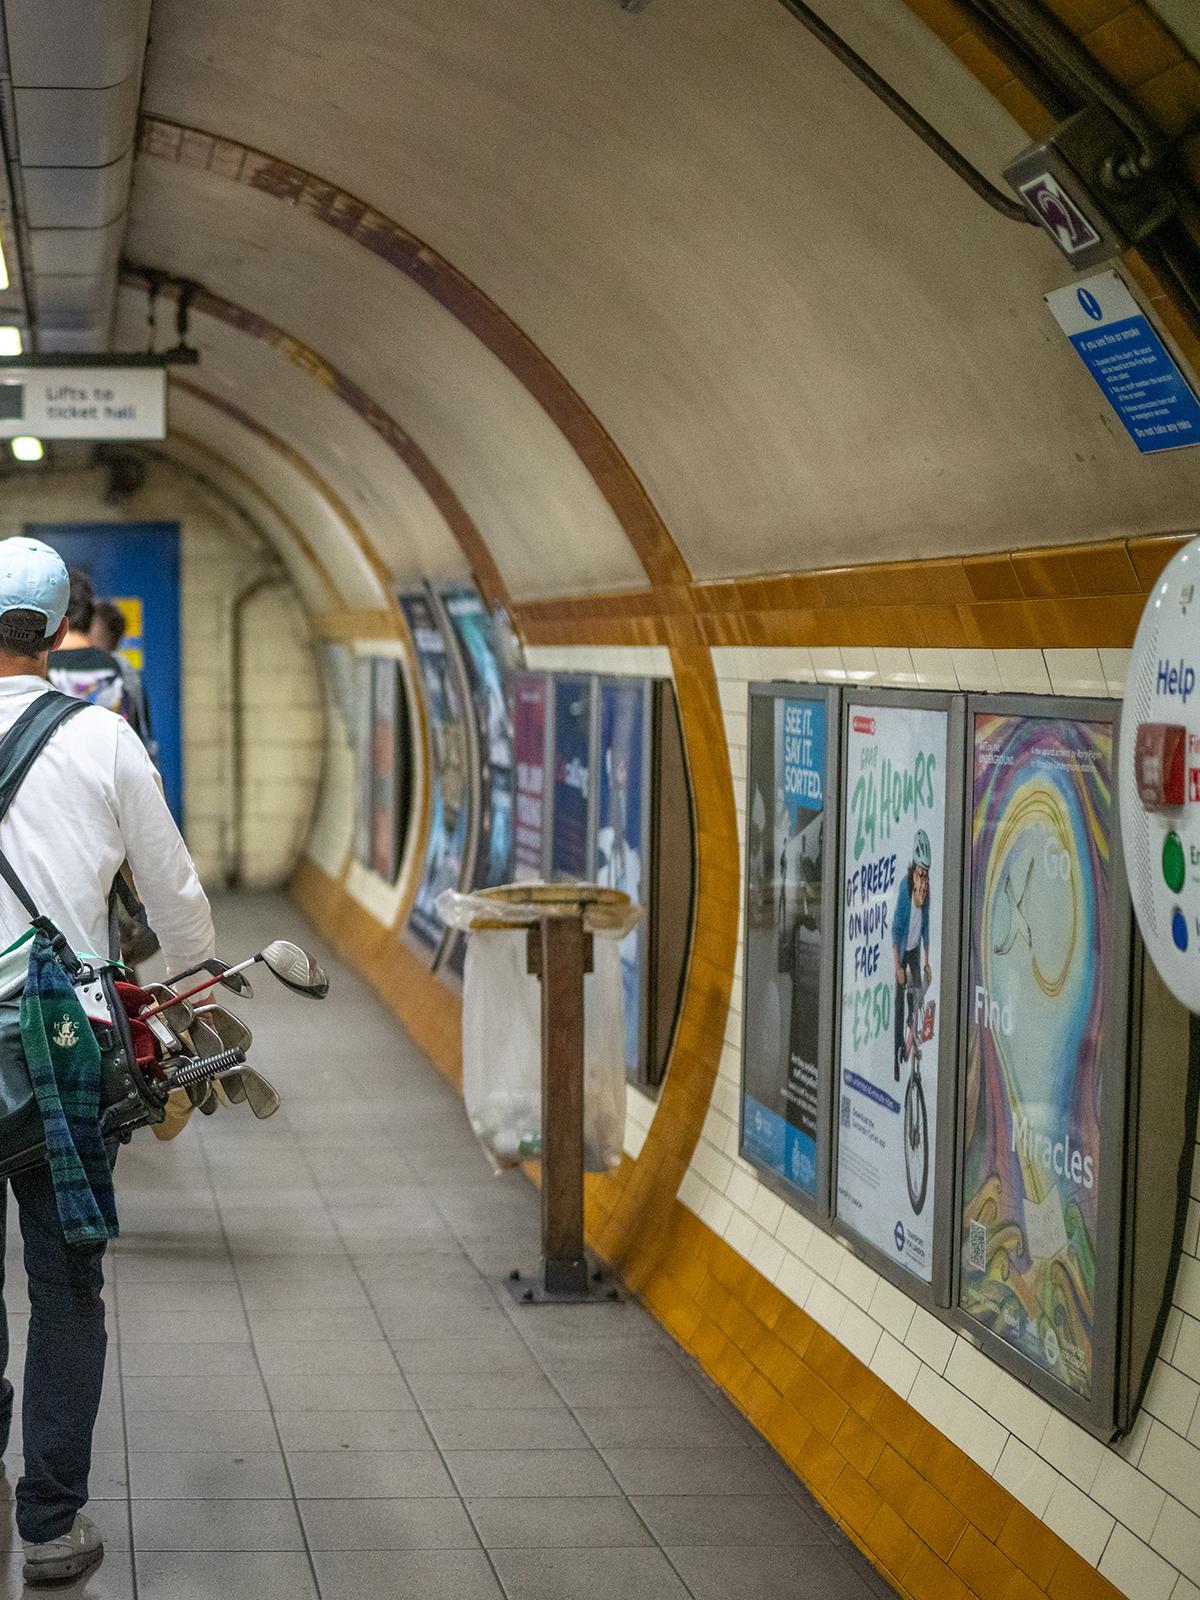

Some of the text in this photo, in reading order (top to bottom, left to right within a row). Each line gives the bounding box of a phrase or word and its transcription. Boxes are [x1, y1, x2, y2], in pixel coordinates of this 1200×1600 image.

[46, 386, 88, 402] Lifts
[92, 388, 114, 402] to
[46, 403, 137, 420] ticket hall
[1156, 658, 1196, 705] Help
[785, 706, 813, 737] SEE IT.
[785, 735, 813, 767] SAY IT.
[785, 765, 823, 800] SORTED.
[851, 770, 878, 861] 24
[1043, 836, 1071, 881] Go
[846, 854, 897, 908] OF BREEZE
[848, 900, 888, 946] ON YOUR
[854, 943, 881, 983] FACE
[53, 1021, 80, 1029] H C
[62, 1013, 70, 1021] G
[975, 985, 1014, 1037] Find
[1012, 1111, 1094, 1190] Miracles
